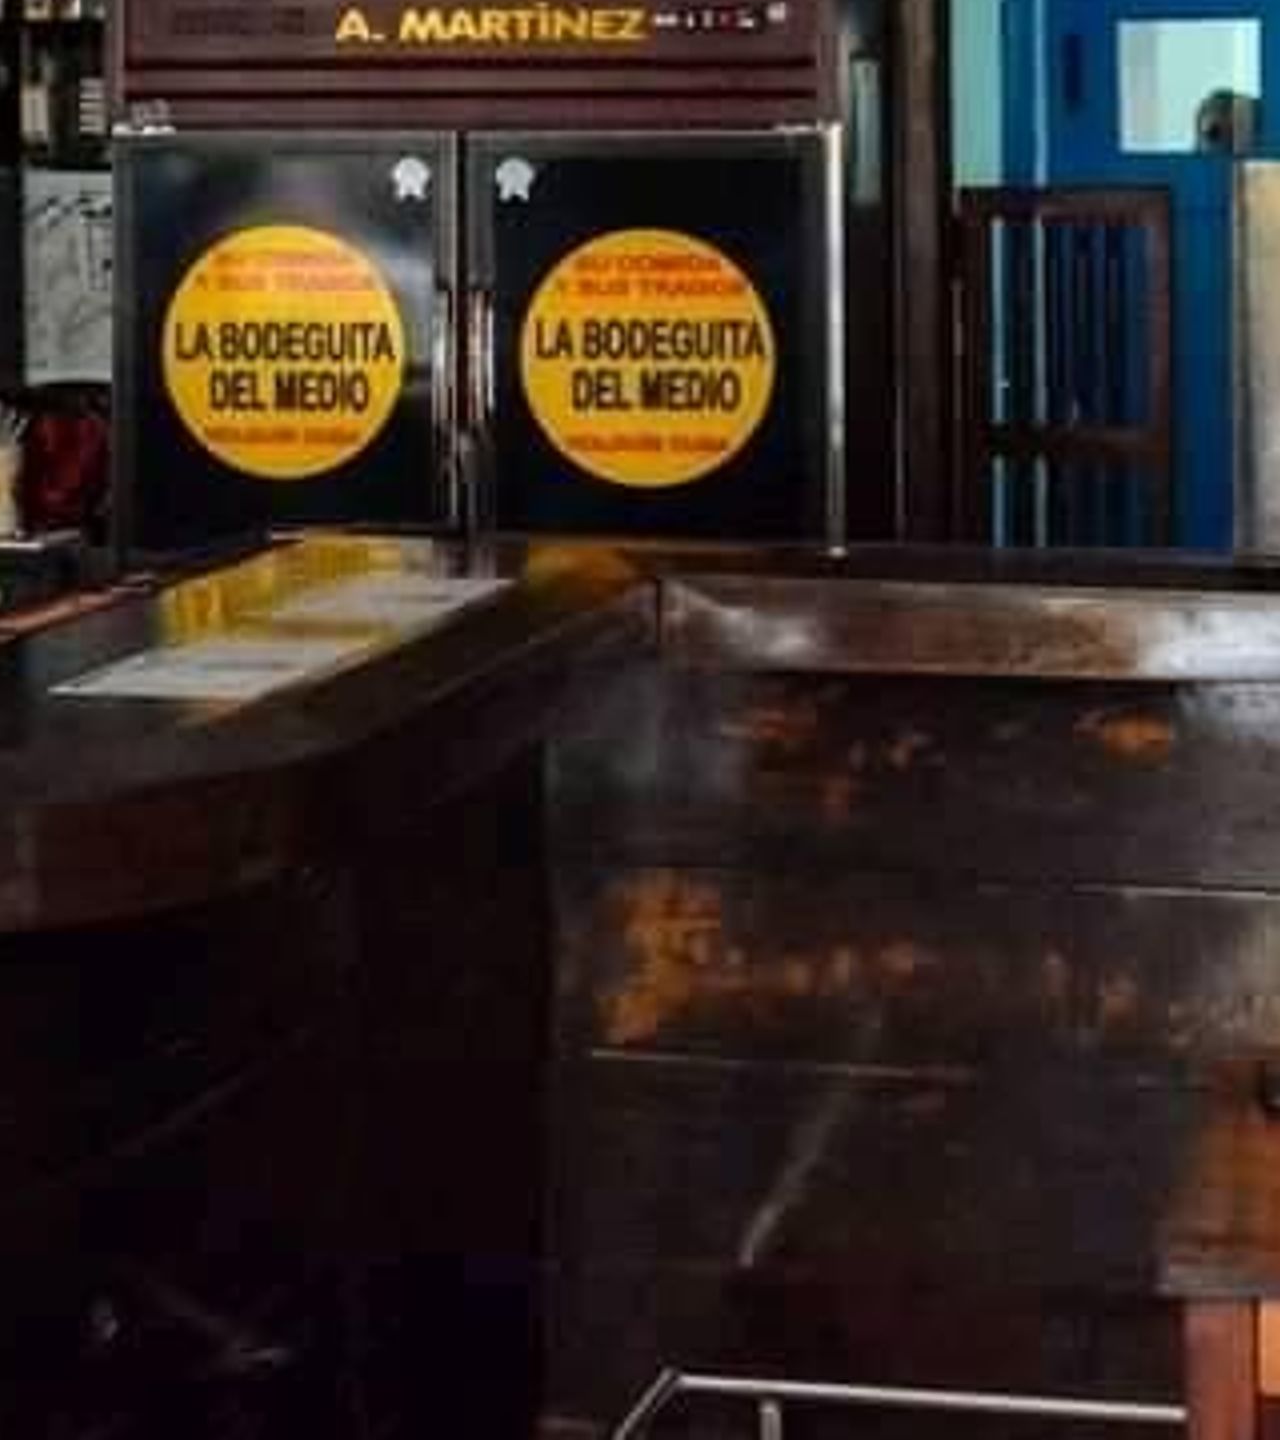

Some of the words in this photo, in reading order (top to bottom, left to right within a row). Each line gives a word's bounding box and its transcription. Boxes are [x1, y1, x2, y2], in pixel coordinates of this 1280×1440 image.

[334, 6, 386, 42] A.
[175, 322, 212, 362] LA
[218, 321, 396, 362] BODEGUITA
[535, 319, 573, 360] LA
[582, 318, 766, 361] BODEGUITA
[210, 370, 267, 413] DEL
[274, 368, 370, 414] MEDIO
[571, 368, 632, 412] DEL
[639, 367, 742, 414] MEDIO
